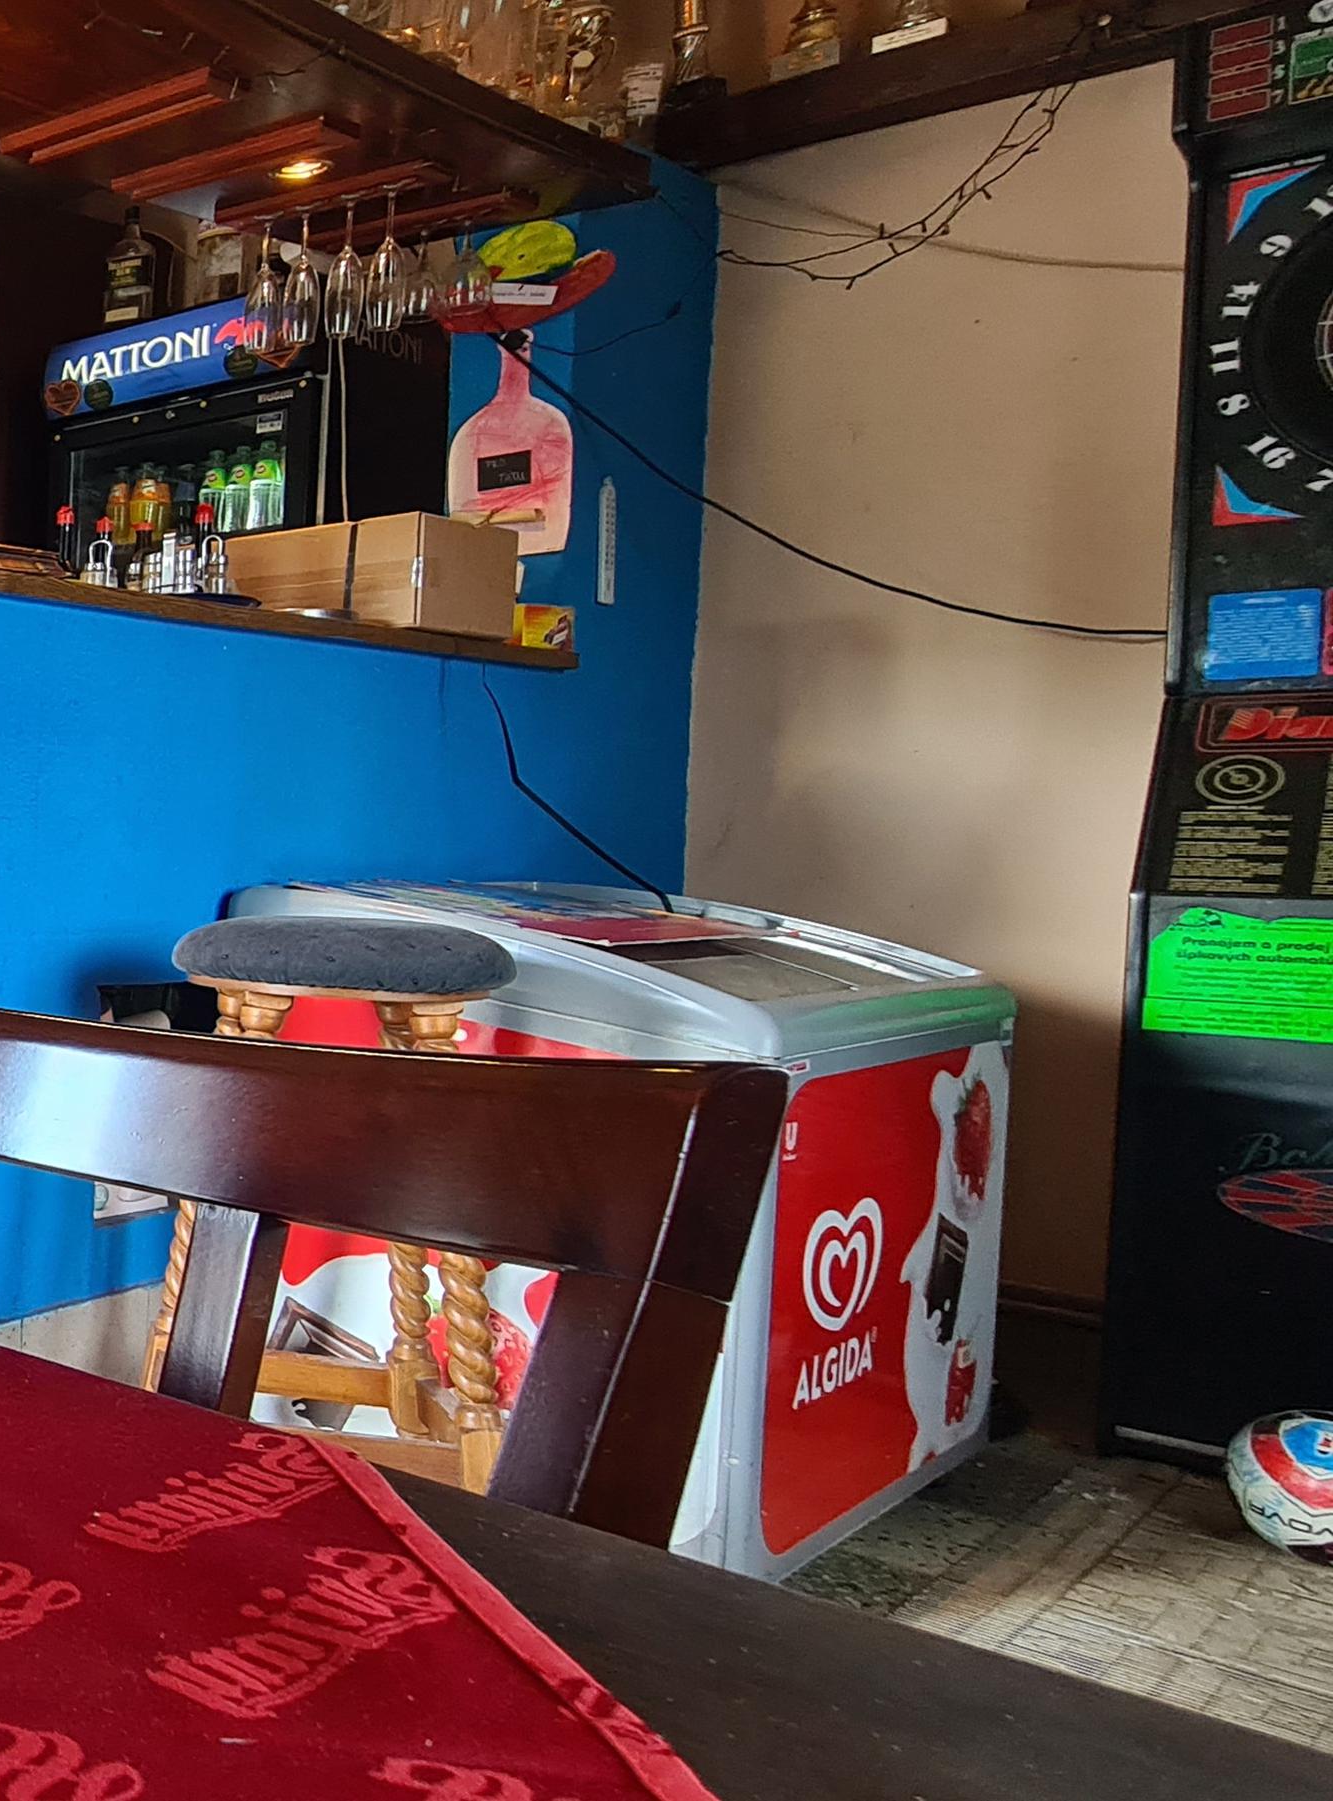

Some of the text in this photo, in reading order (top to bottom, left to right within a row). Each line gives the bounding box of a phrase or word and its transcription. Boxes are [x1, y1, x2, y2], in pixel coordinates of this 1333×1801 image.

[1221, 280, 1261, 320] 14
[61, 324, 211, 384] MATTONI
[1208, 336, 1241, 376] 11
[1217, 393, 1251, 416] 8
[1241, 434, 1297, 470] 16
[791, 1331, 873, 1410] ALGIDA
